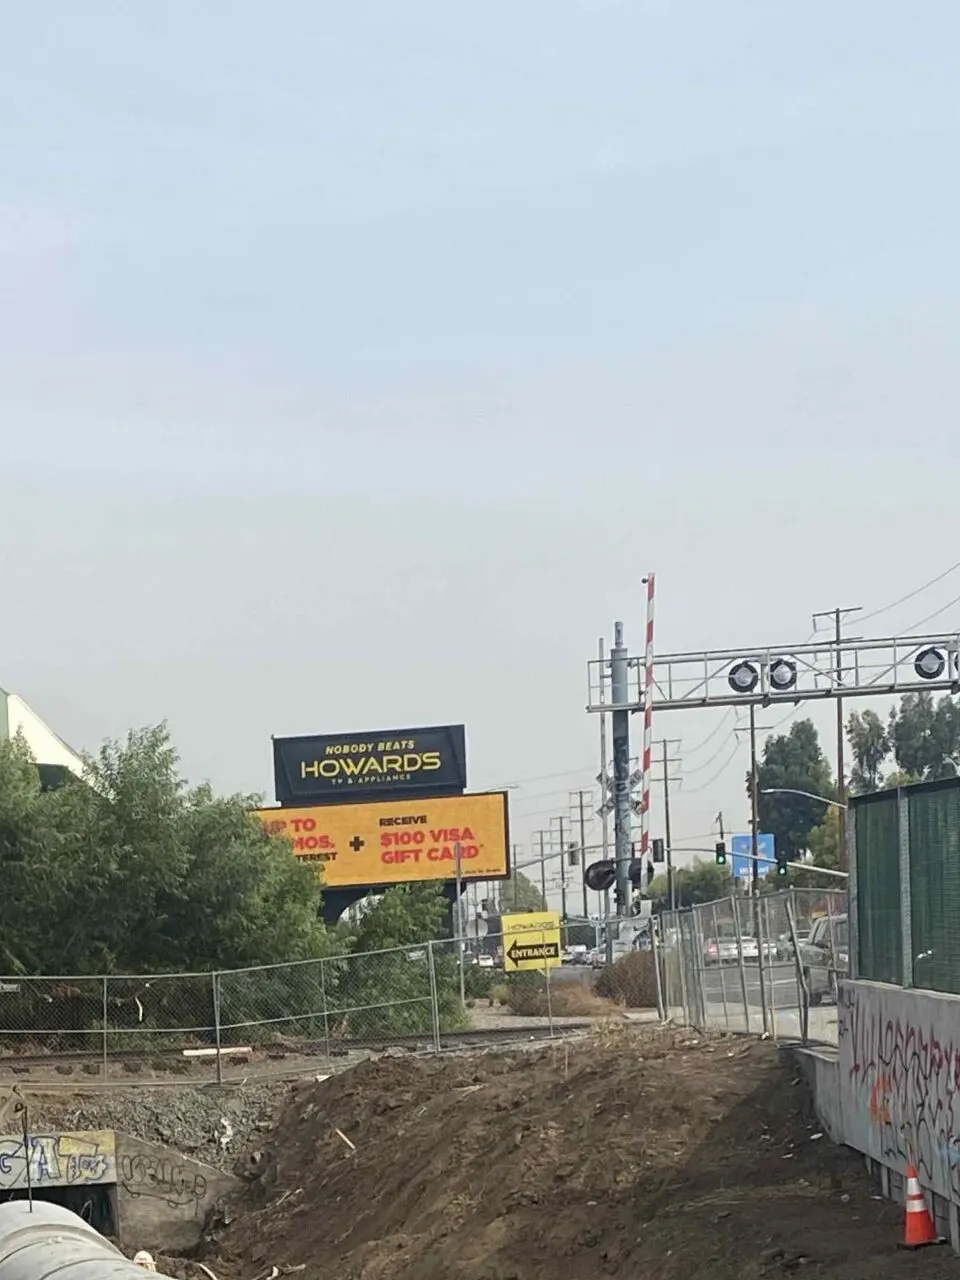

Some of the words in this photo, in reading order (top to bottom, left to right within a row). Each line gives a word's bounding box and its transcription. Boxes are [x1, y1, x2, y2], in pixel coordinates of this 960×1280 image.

[325, 743, 374, 755] NOBODY
[377, 740, 415, 752] BEATS
[357, 773, 411, 784] APPLIANCE
[291, 818, 316, 832] TO
[379, 815, 427, 827] RECEIVE
[381, 831, 425, 847] $100
[430, 828, 475, 842] VISA
[381, 849, 422, 864] GIFT
[511, 946, 556, 958] ENTRANCE
